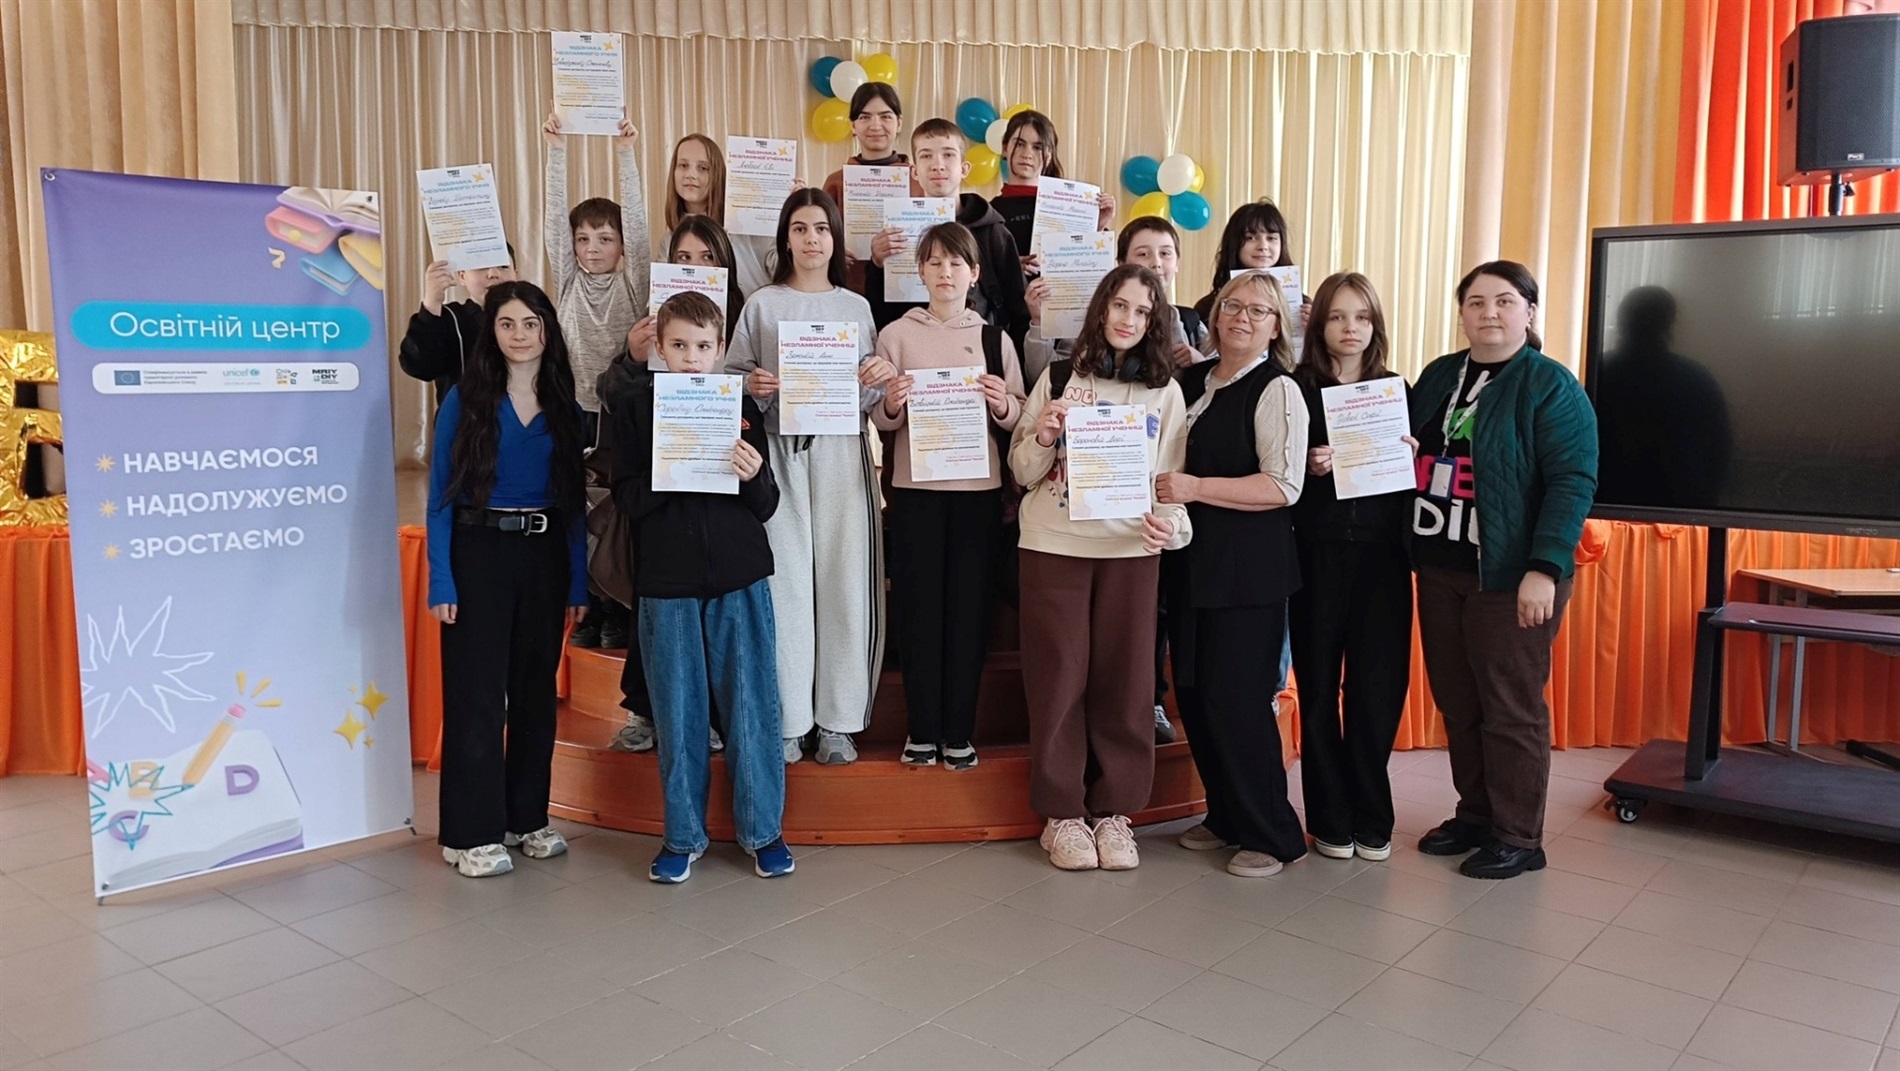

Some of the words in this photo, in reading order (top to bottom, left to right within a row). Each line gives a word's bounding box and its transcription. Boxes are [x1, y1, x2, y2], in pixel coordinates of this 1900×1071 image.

[109, 311, 243, 338] Освітній
[251, 319, 341, 344] центр
[123, 446, 319, 474] НАВЧАЄМОСЯ
[126, 484, 348, 517] НАДОЛУЖУЄМО
[129, 526, 305, 559] ЗРОСТАЄМО
